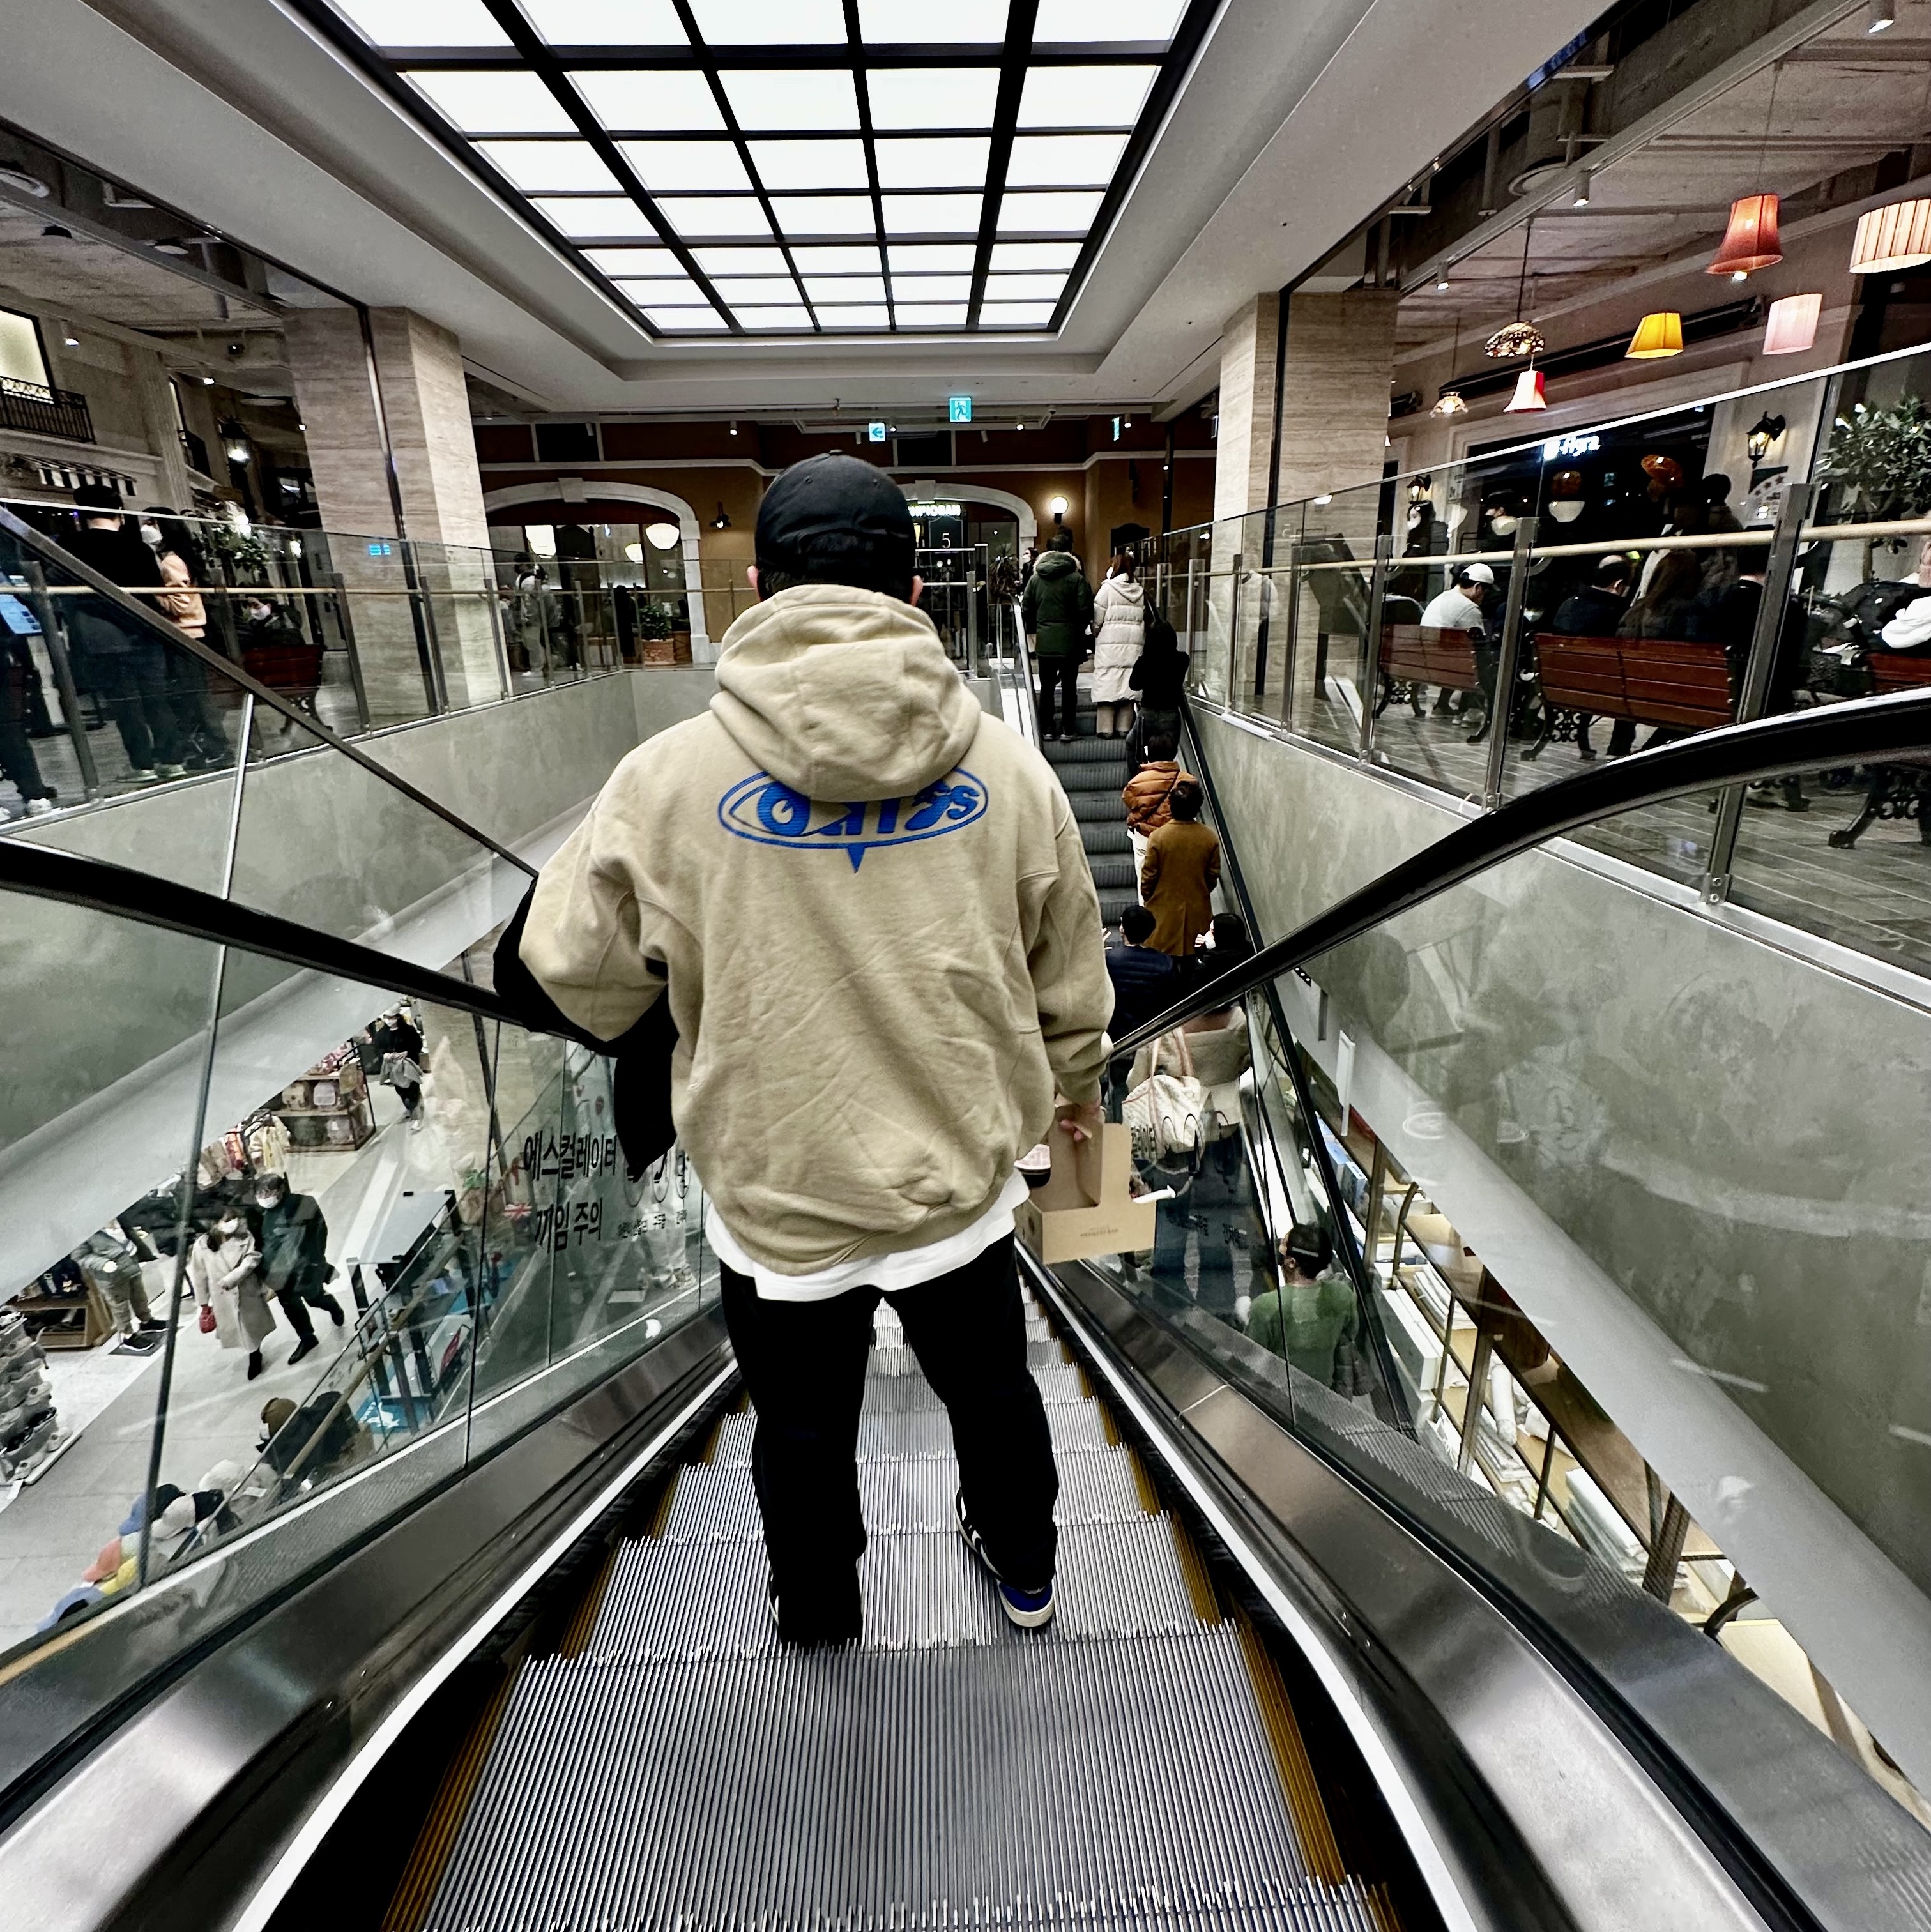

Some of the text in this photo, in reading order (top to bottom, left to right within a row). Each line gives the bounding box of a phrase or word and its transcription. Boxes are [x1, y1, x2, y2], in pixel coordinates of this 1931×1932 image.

[942, 533, 951, 549] 5
[524, 1130, 618, 1181] 에스컬레이터
[535, 1201, 570, 1254] 끼임
[573, 1197, 603, 1246] 주의
